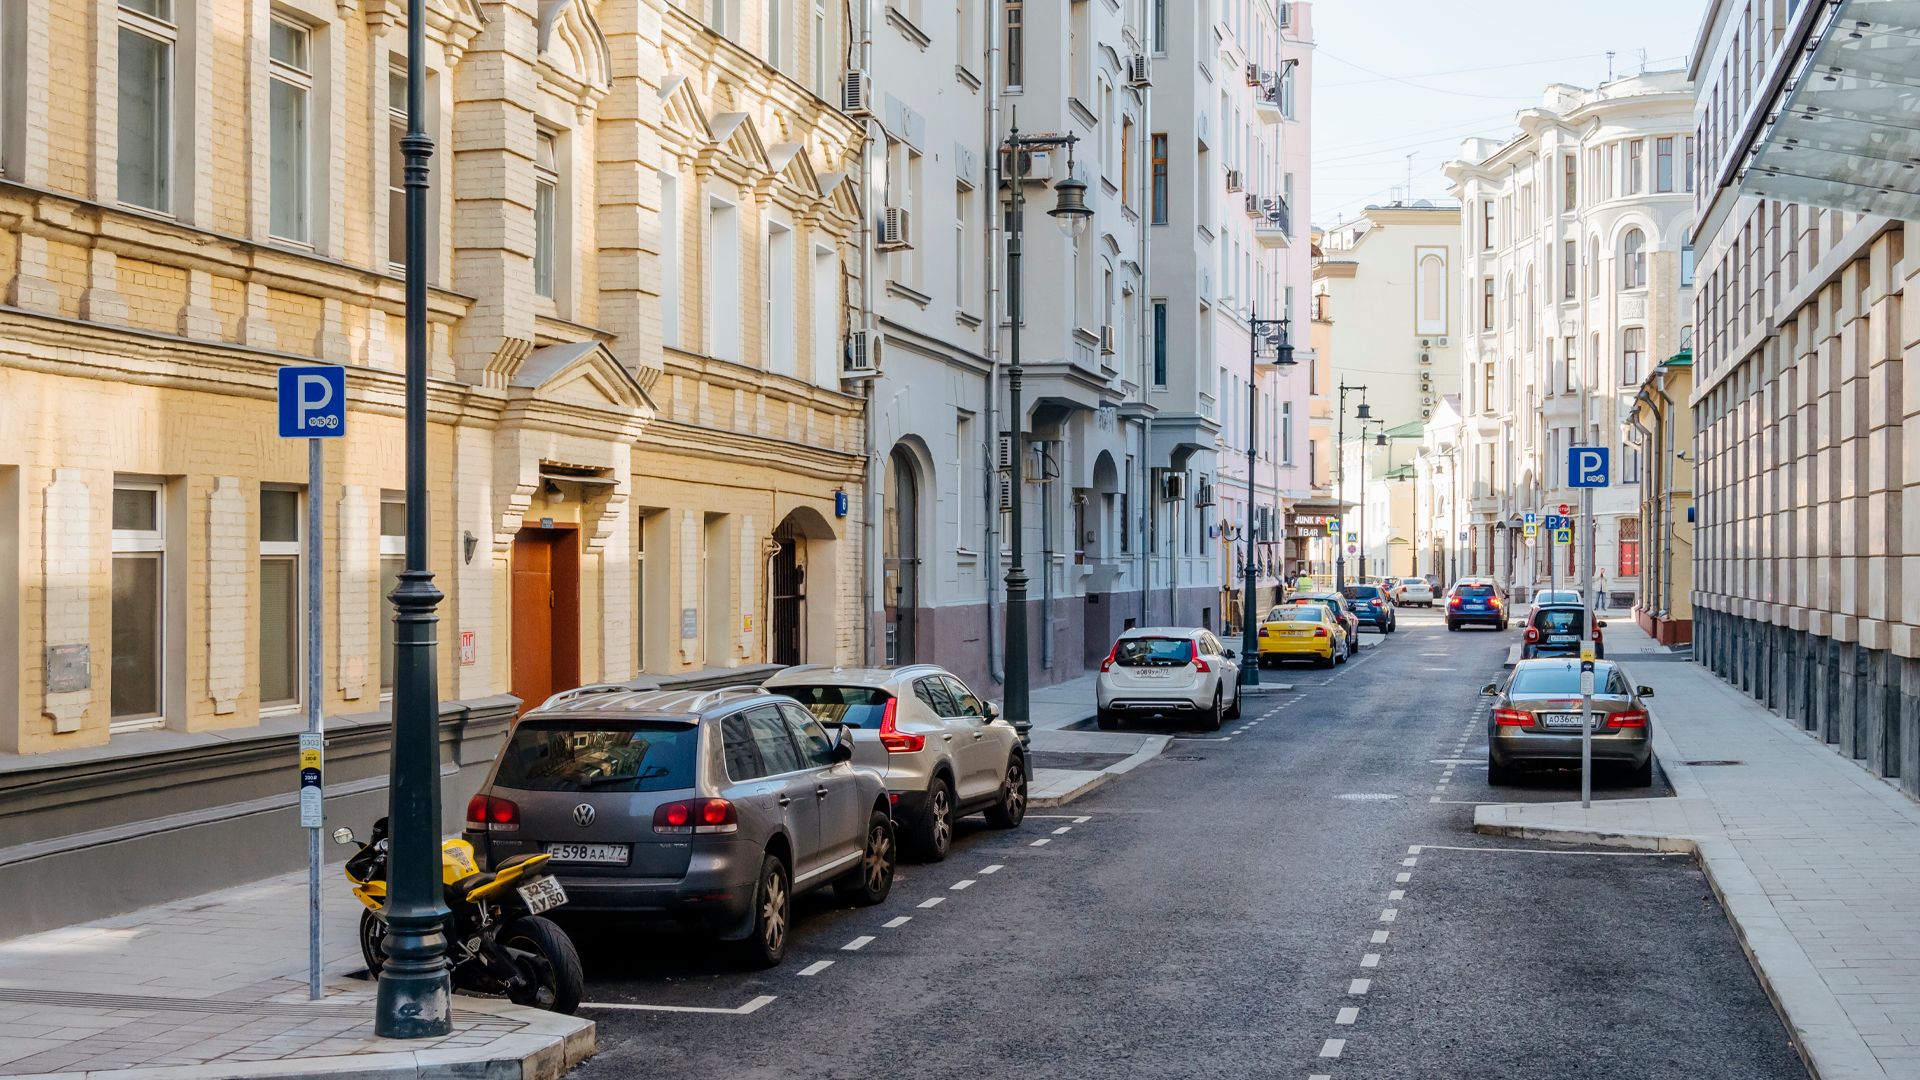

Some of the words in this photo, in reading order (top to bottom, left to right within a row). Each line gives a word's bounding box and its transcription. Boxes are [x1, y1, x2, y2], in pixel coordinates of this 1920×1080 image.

[298, 375, 333, 429] P
[1580, 452, 1602, 483] P
[843, 498, 846, 510] 6
[1295, 516, 1314, 524] JUNK
[1549, 517, 1557, 528] P
[524, 880, 554, 897] 3253
